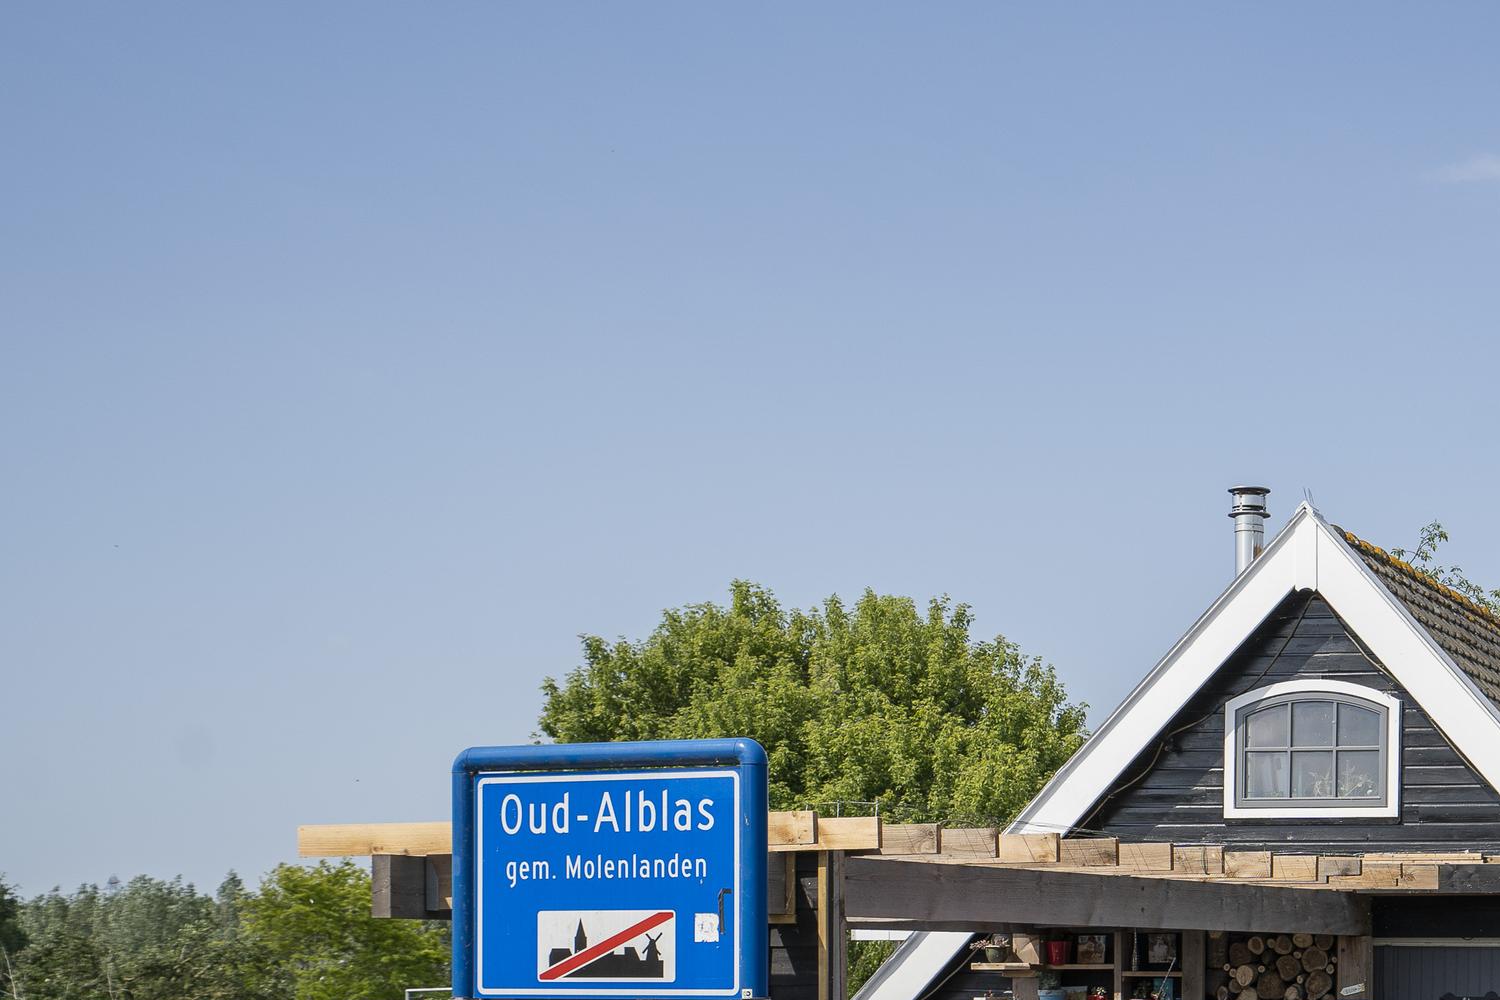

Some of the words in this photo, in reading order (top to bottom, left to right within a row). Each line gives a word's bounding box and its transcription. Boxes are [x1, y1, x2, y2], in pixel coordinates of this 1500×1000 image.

[500, 789, 715, 835] Oud-Alblas
[505, 860, 557, 888] gem.
[565, 852, 707, 880] Molenlanden
